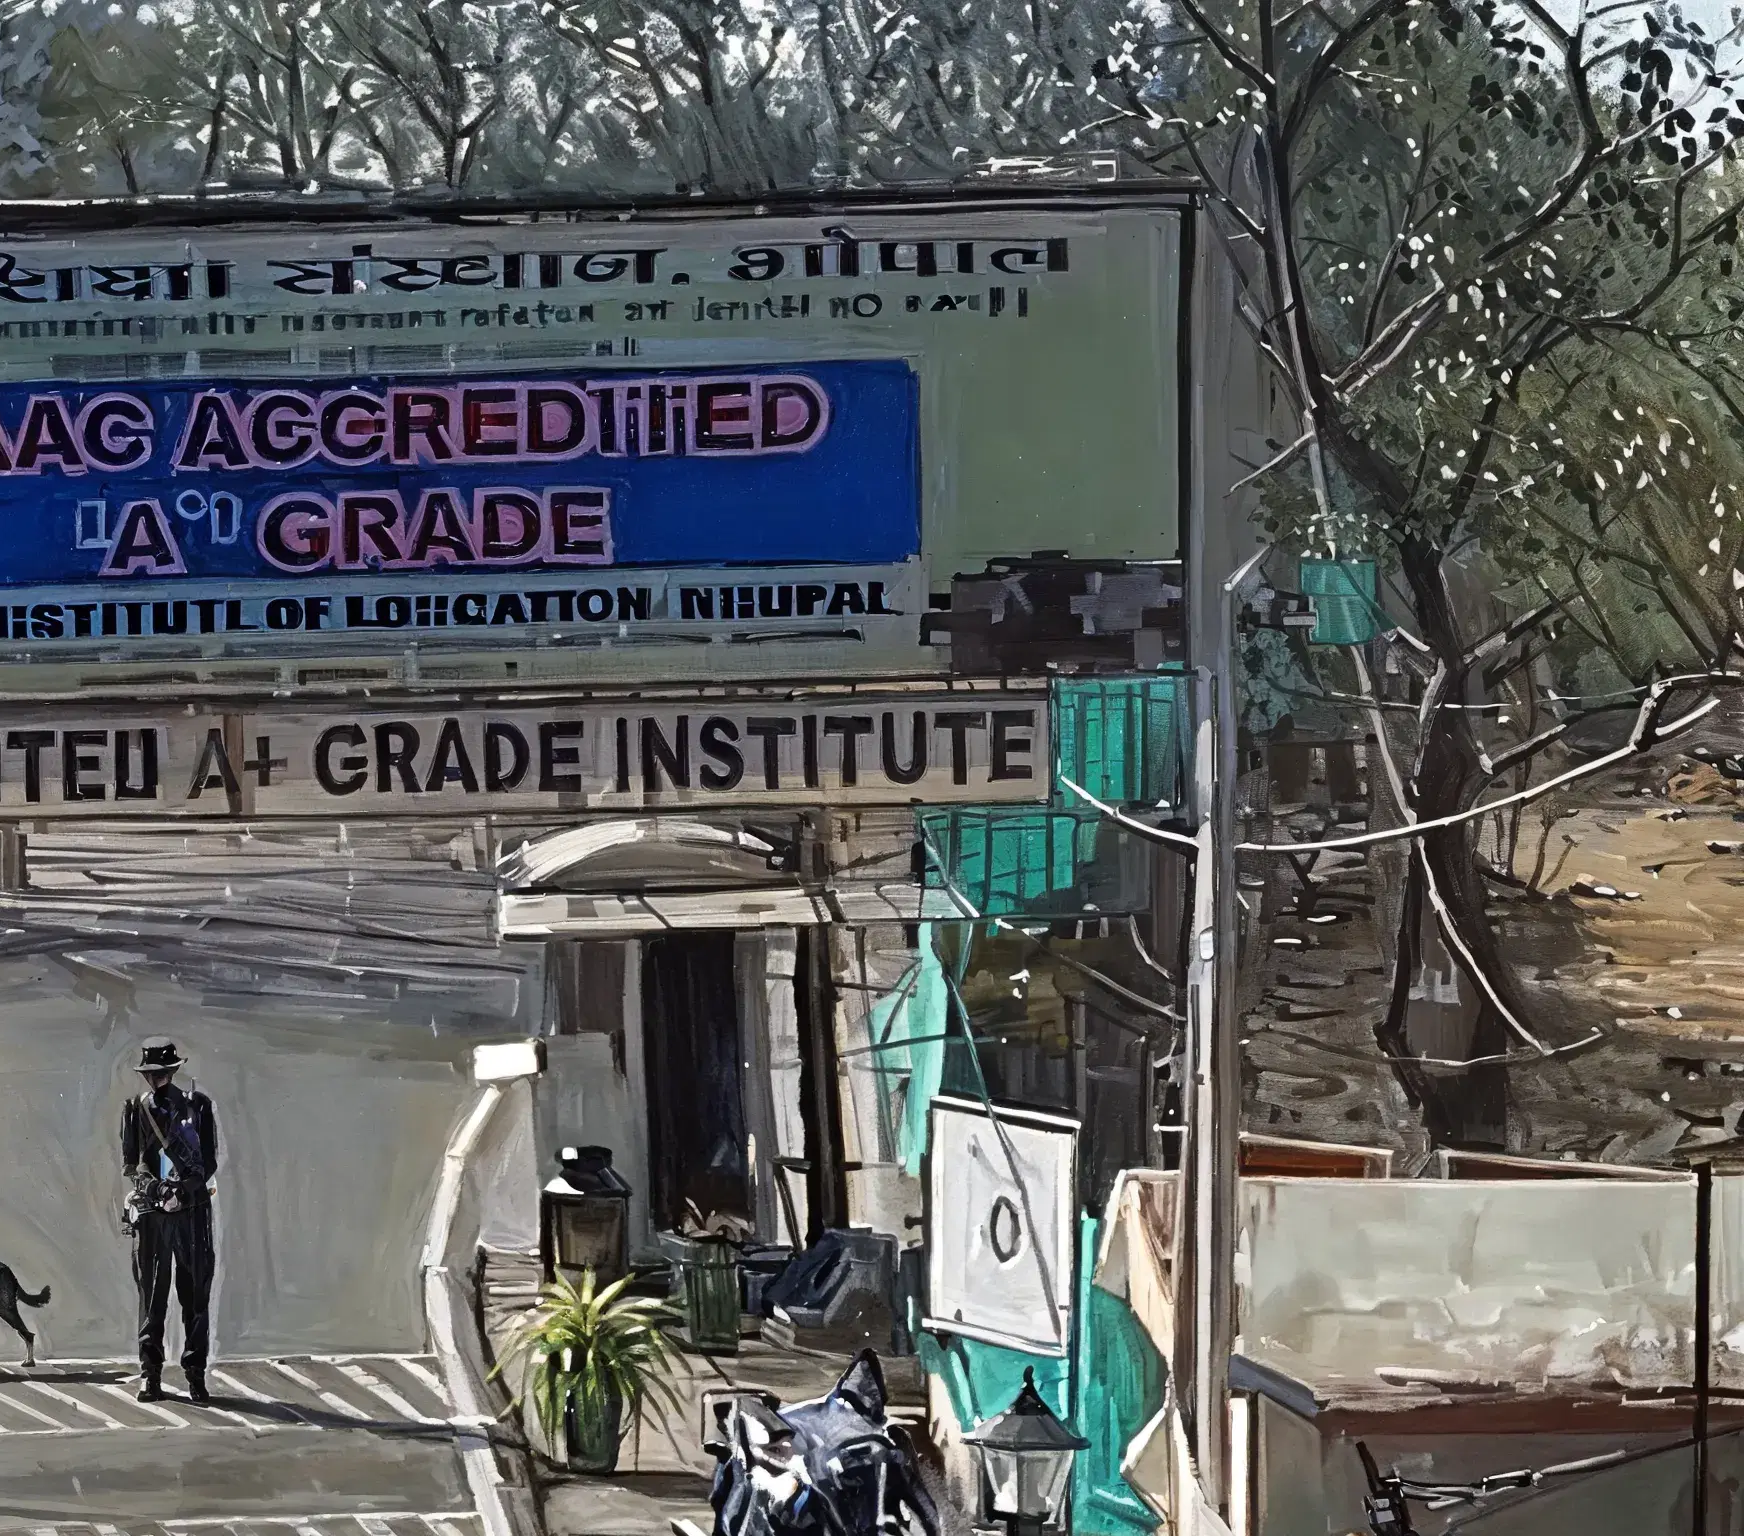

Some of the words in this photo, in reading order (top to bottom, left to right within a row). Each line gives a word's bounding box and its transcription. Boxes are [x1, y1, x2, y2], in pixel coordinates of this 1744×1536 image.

[256, 486, 613, 573] GRADE
[266, 596, 332, 630] OF
[314, 717, 584, 797] GRADE
[615, 710, 1034, 794] INSTITUTE
